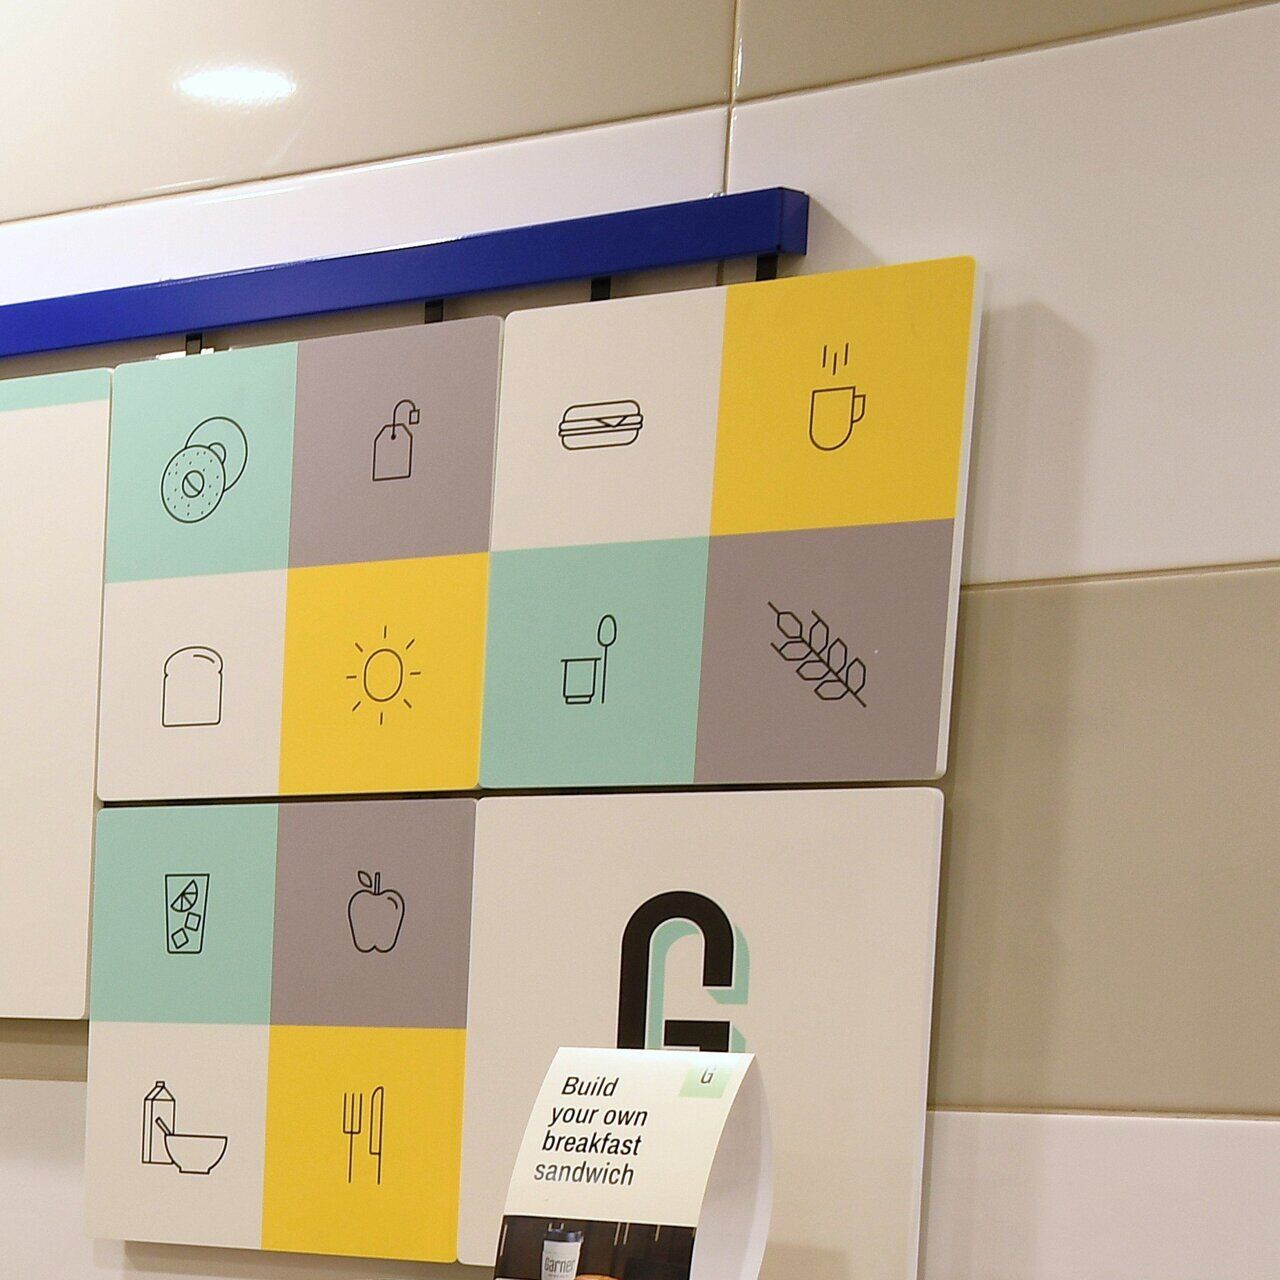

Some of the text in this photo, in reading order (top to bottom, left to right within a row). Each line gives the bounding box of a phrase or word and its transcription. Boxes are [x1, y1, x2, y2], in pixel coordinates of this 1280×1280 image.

[561, 1076, 620, 1097] Build
[547, 1106, 648, 1127] your own
[541, 1130, 642, 1156] breakfast
[533, 1160, 635, 1186] sandwich
[544, 1256, 576, 1273] Garner
